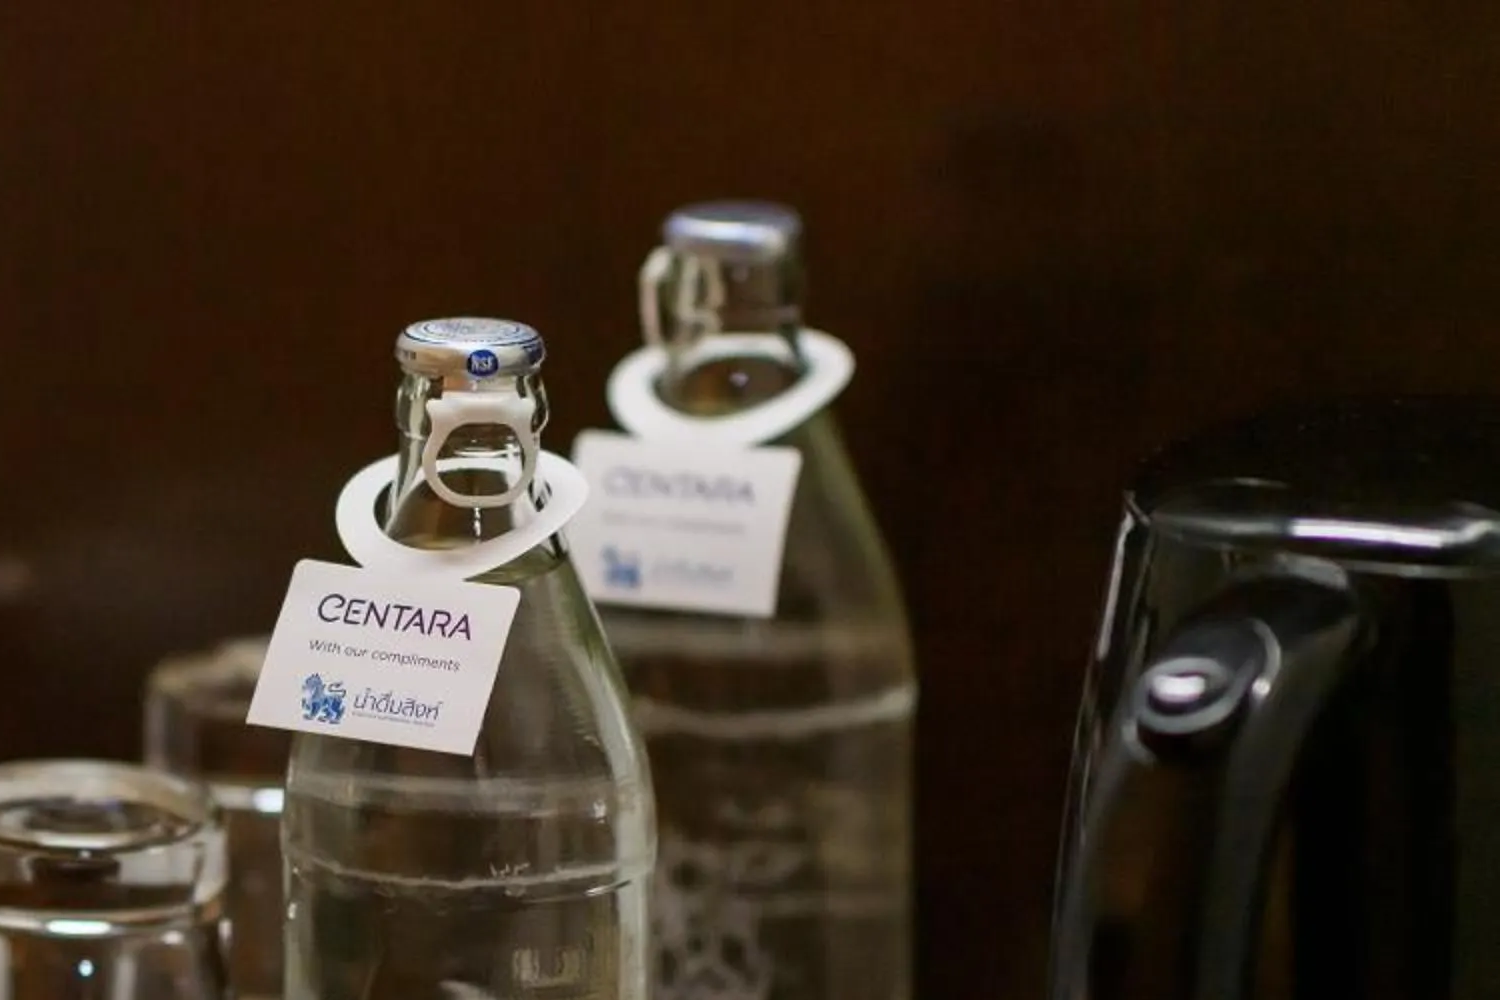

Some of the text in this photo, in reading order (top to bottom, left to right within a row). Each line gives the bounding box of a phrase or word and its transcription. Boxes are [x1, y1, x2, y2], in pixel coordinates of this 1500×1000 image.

[317, 593, 472, 641] CENTARA
[309, 639, 461, 673] With our compliments
